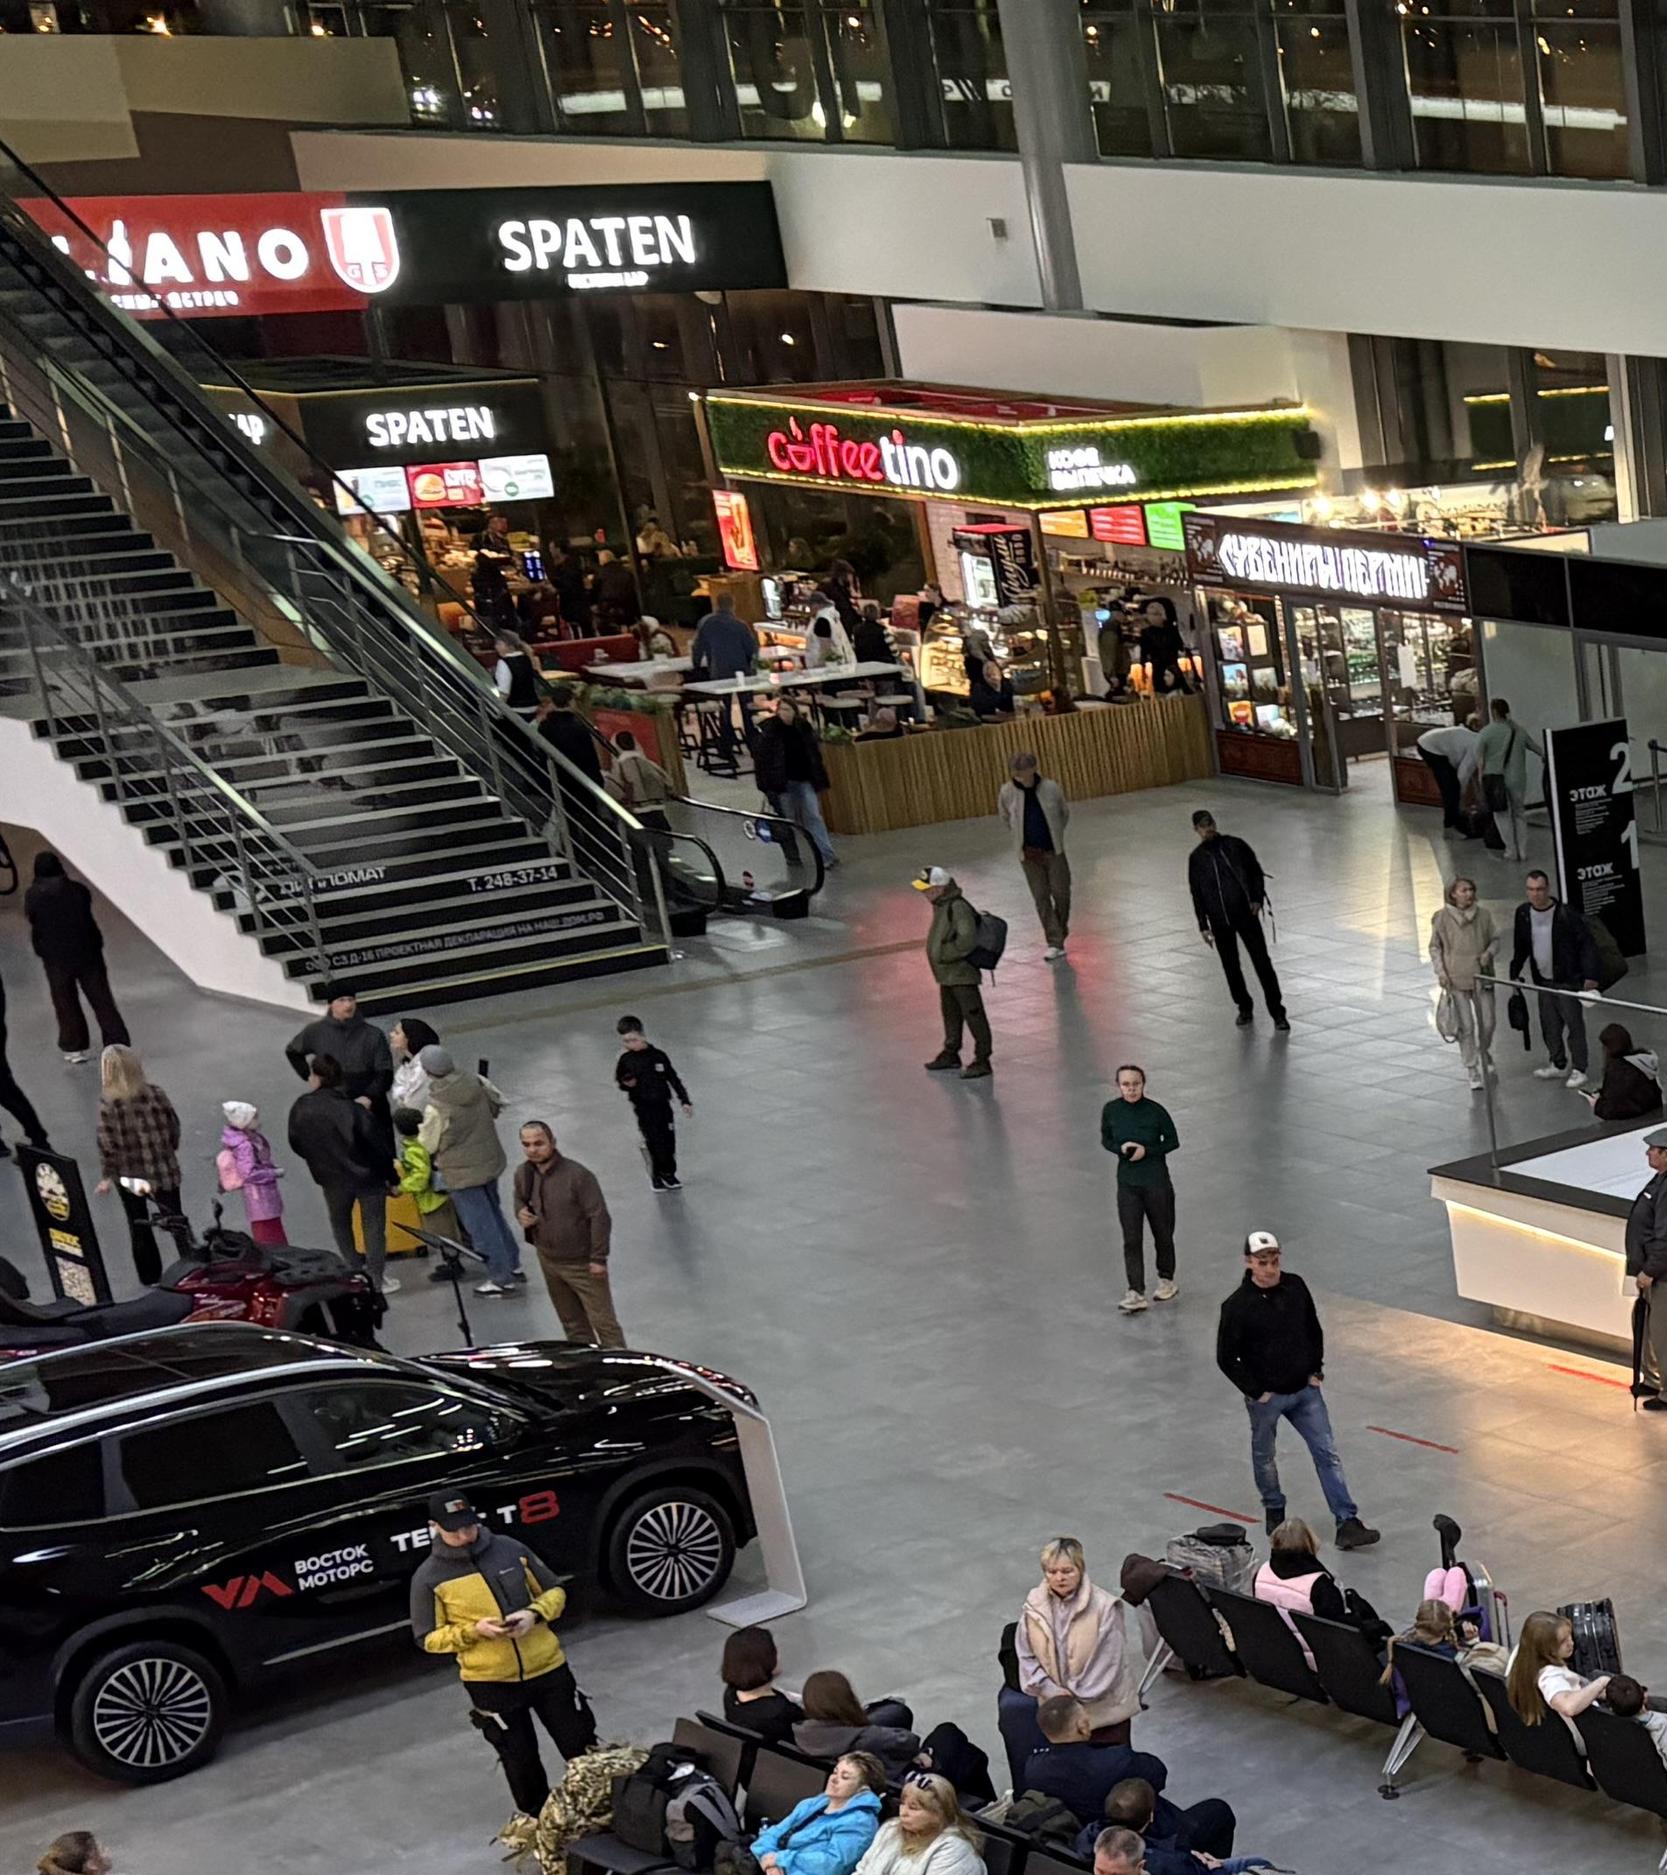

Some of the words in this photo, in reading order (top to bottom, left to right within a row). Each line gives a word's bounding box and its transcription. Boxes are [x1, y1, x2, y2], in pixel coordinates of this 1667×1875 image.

[498, 214, 696, 272] SPATEN
[365, 405, 496, 447] SPATEN
[1609, 741, 1633, 795] 2
[1620, 819, 1640, 870] 1
[484, 865, 559, 889] 248-37-14
[496, 1489, 561, 1526] T8
[293, 1543, 370, 1576] ВОСТОК
[297, 1559, 375, 1592] МОТОРС
